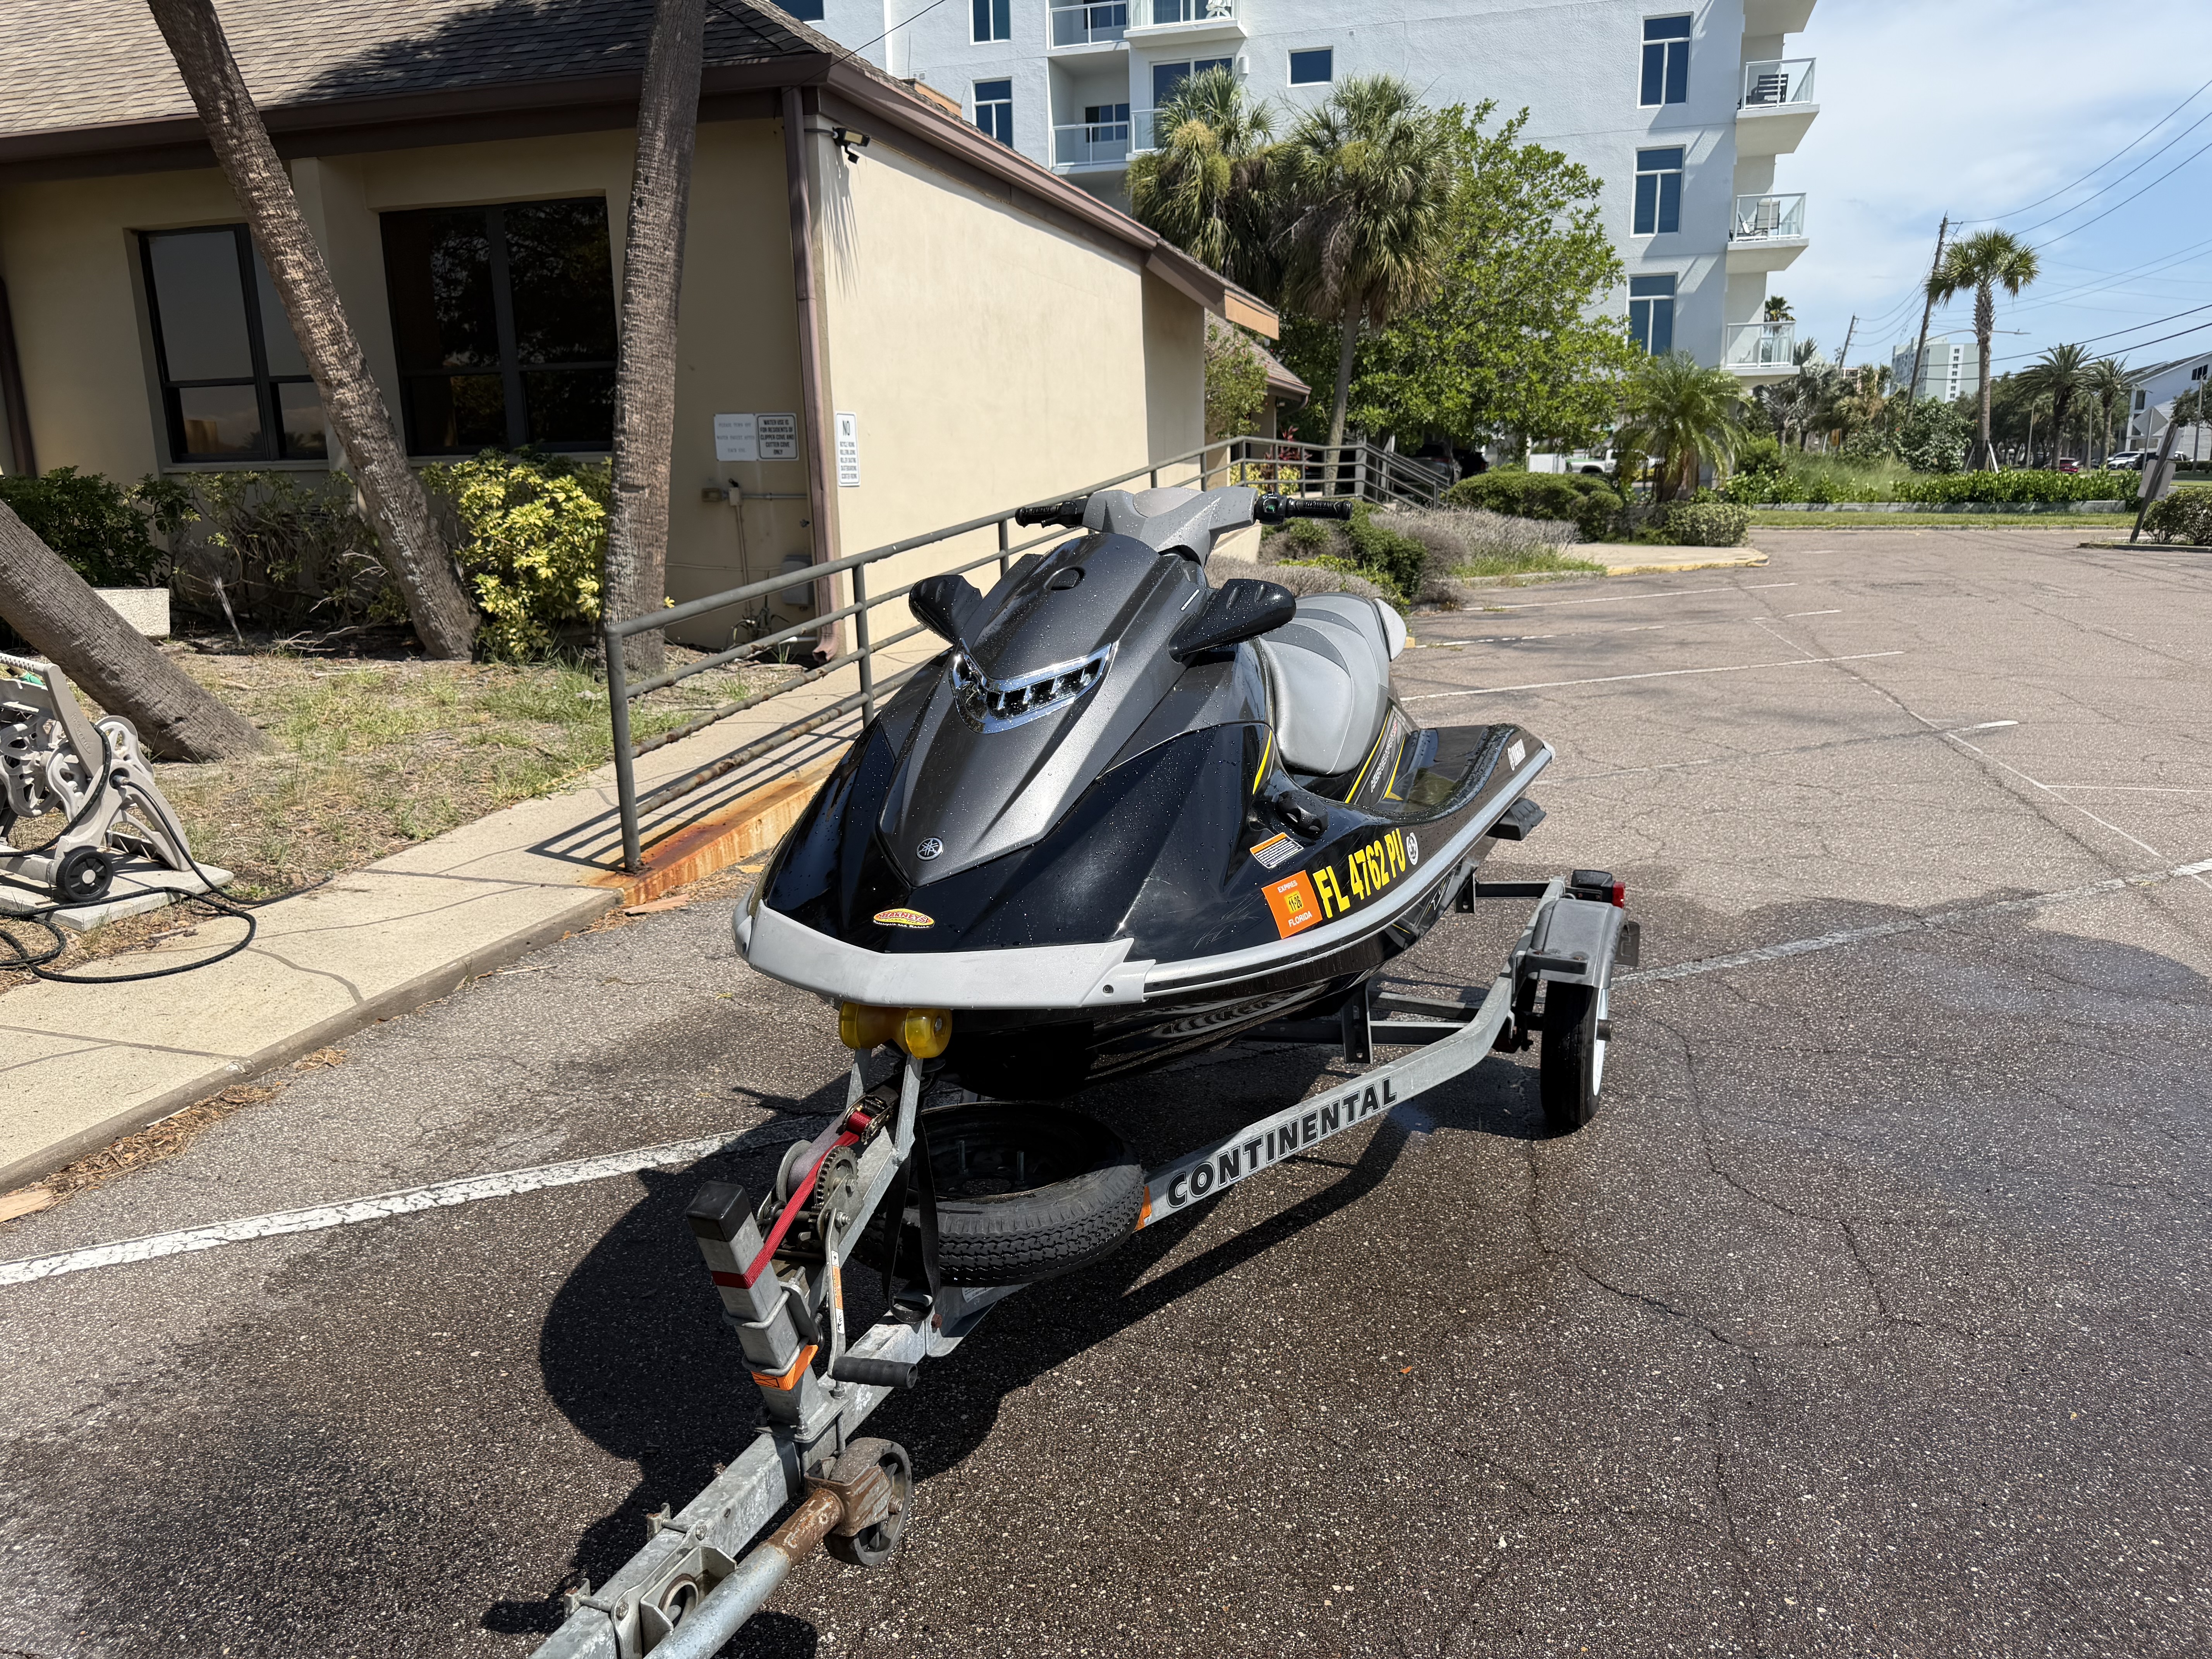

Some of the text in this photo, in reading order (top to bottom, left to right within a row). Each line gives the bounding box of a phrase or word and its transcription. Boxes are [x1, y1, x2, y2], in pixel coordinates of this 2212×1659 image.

[842, 420, 850, 436] NO
[1312, 866, 1351, 918] FL
[1348, 840, 1390, 900] 4762
[1384, 828, 1406, 878] PU
[1277, 880, 1298, 893] EXPIRES
[1288, 910, 1313, 927] FLORIDA
[1166, 1076, 1397, 1208] CONTINENTAL
